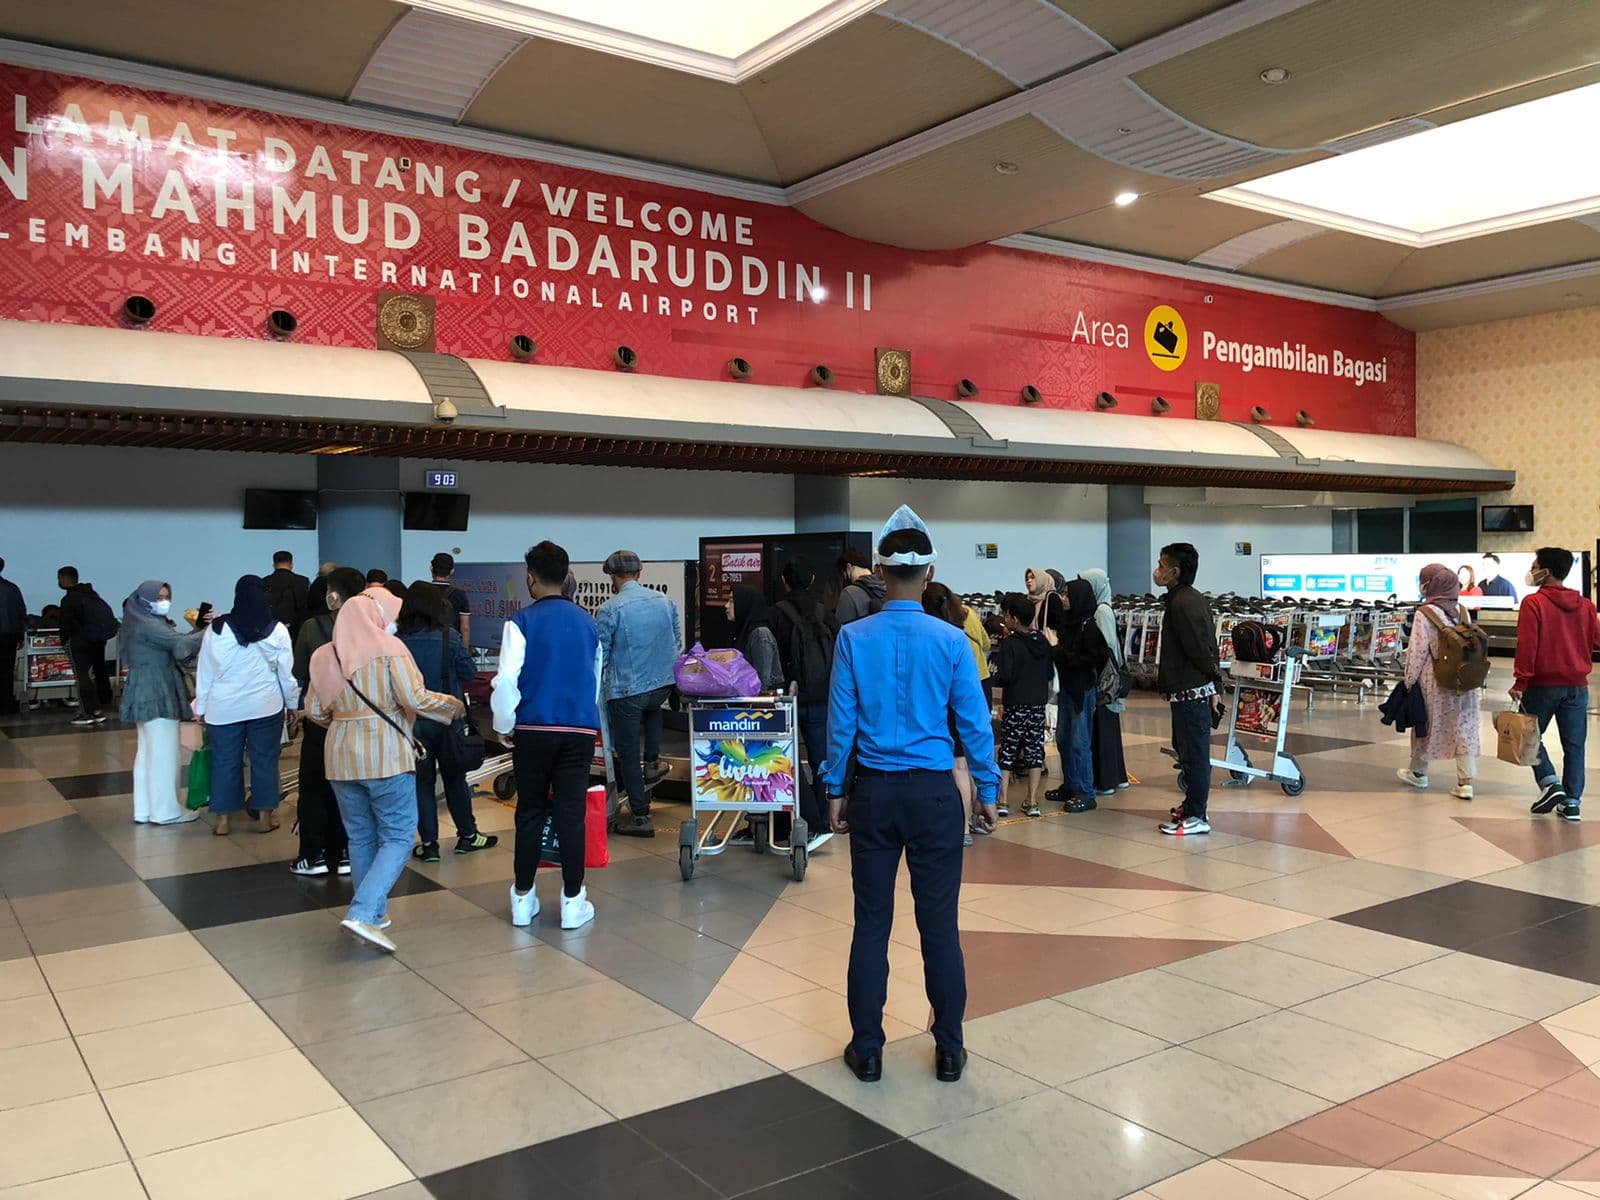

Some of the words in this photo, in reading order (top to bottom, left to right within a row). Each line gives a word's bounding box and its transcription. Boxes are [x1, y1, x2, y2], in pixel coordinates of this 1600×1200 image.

[15, 94, 237, 164] LAMAT
[264, 137, 481, 203] DATANG
[502, 179, 521, 208] /
[540, 182, 754, 246] WELCOME
[81, 156, 421, 250] MAHMUD
[459, 213, 823, 304] BADARUDDIN
[846, 271, 871, 311] II
[271, 248, 603, 308] INTERNATIONAL
[618, 295, 759, 326] AIRPORT
[1071, 310, 1129, 349] Area
[1202, 330, 1329, 372] Pengambilan
[1332, 350, 1388, 387] Bagasi
[709, 718, 760, 731] mandiri
